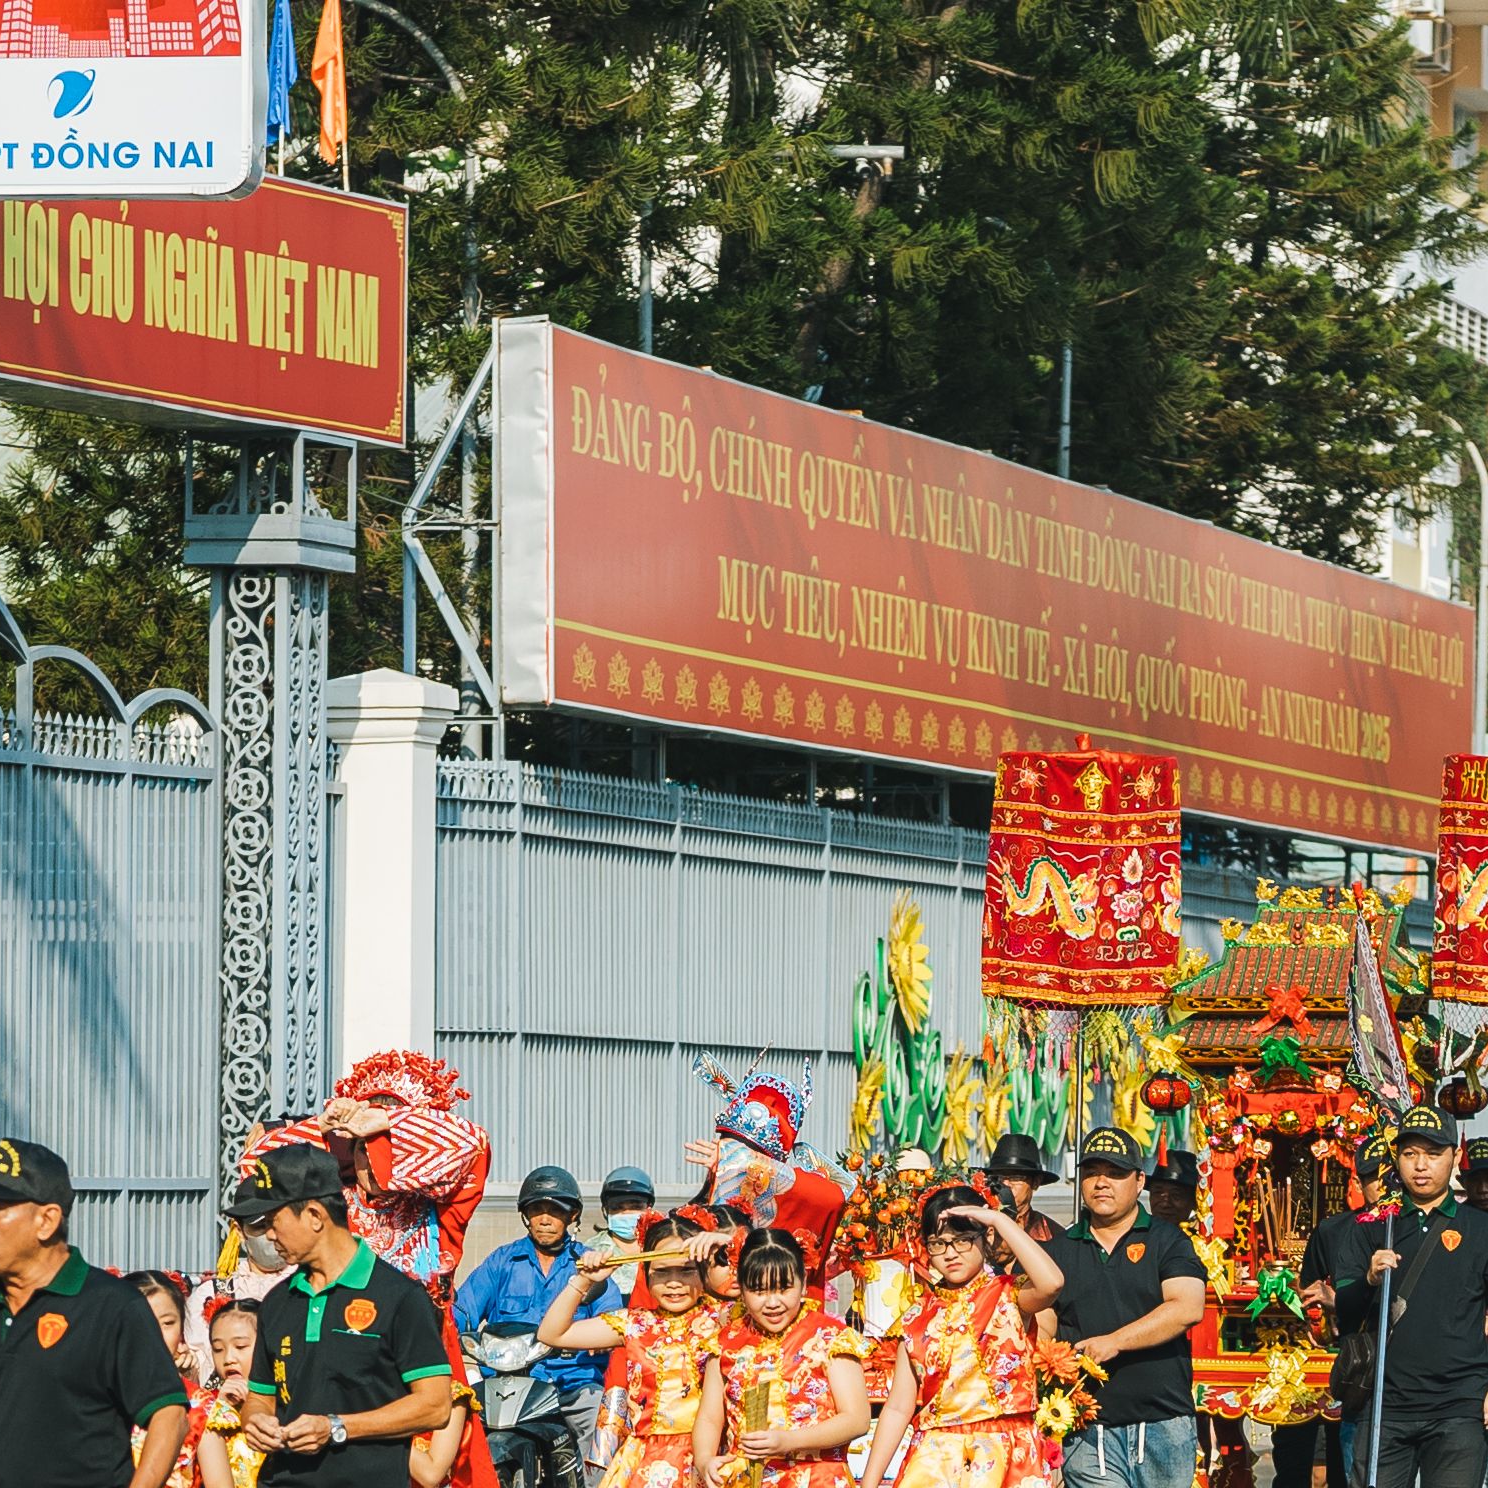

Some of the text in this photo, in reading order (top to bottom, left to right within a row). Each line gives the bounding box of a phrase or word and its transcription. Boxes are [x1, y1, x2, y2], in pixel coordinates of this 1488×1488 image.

[31, 128, 140, 169] ĐỒNG
[154, 141, 214, 169] NAI
[69, 200, 134, 323] CHỦ
[144, 226, 237, 342] NGHĨA
[244, 240, 309, 371] VIỆT
[316, 265, 379, 369] NAM
[571, 363, 1464, 700] ĐẢNG BỘ, CHÍNH QUYỀN VÀ NHÂN DÂN TỈNH ĐỒNG NAI RA SỨC THI ĐUA THỰC HIỆN THẮNG LỢI
[717, 555, 775, 644] MỤC
[781, 555, 846, 658] TIÊU,
[850, 575, 928, 674] NHIỆM
[931, 604, 963, 684] VỤ
[966, 611, 1020, 681] KINH
[1024, 606, 1054, 687] TẾ
[1063, 623, 1089, 696] XÃ
[1093, 627, 1132, 718] HỘI,
[1136, 636, 1186, 722] QUỐC
[1189, 656, 1249, 732] PHÒNG
[1258, 684, 1282, 739] AN
[1282, 690, 1323, 749] NINH
[1325, 688, 1359, 756] NĂM
[1360, 710, 1391, 764] 2025
